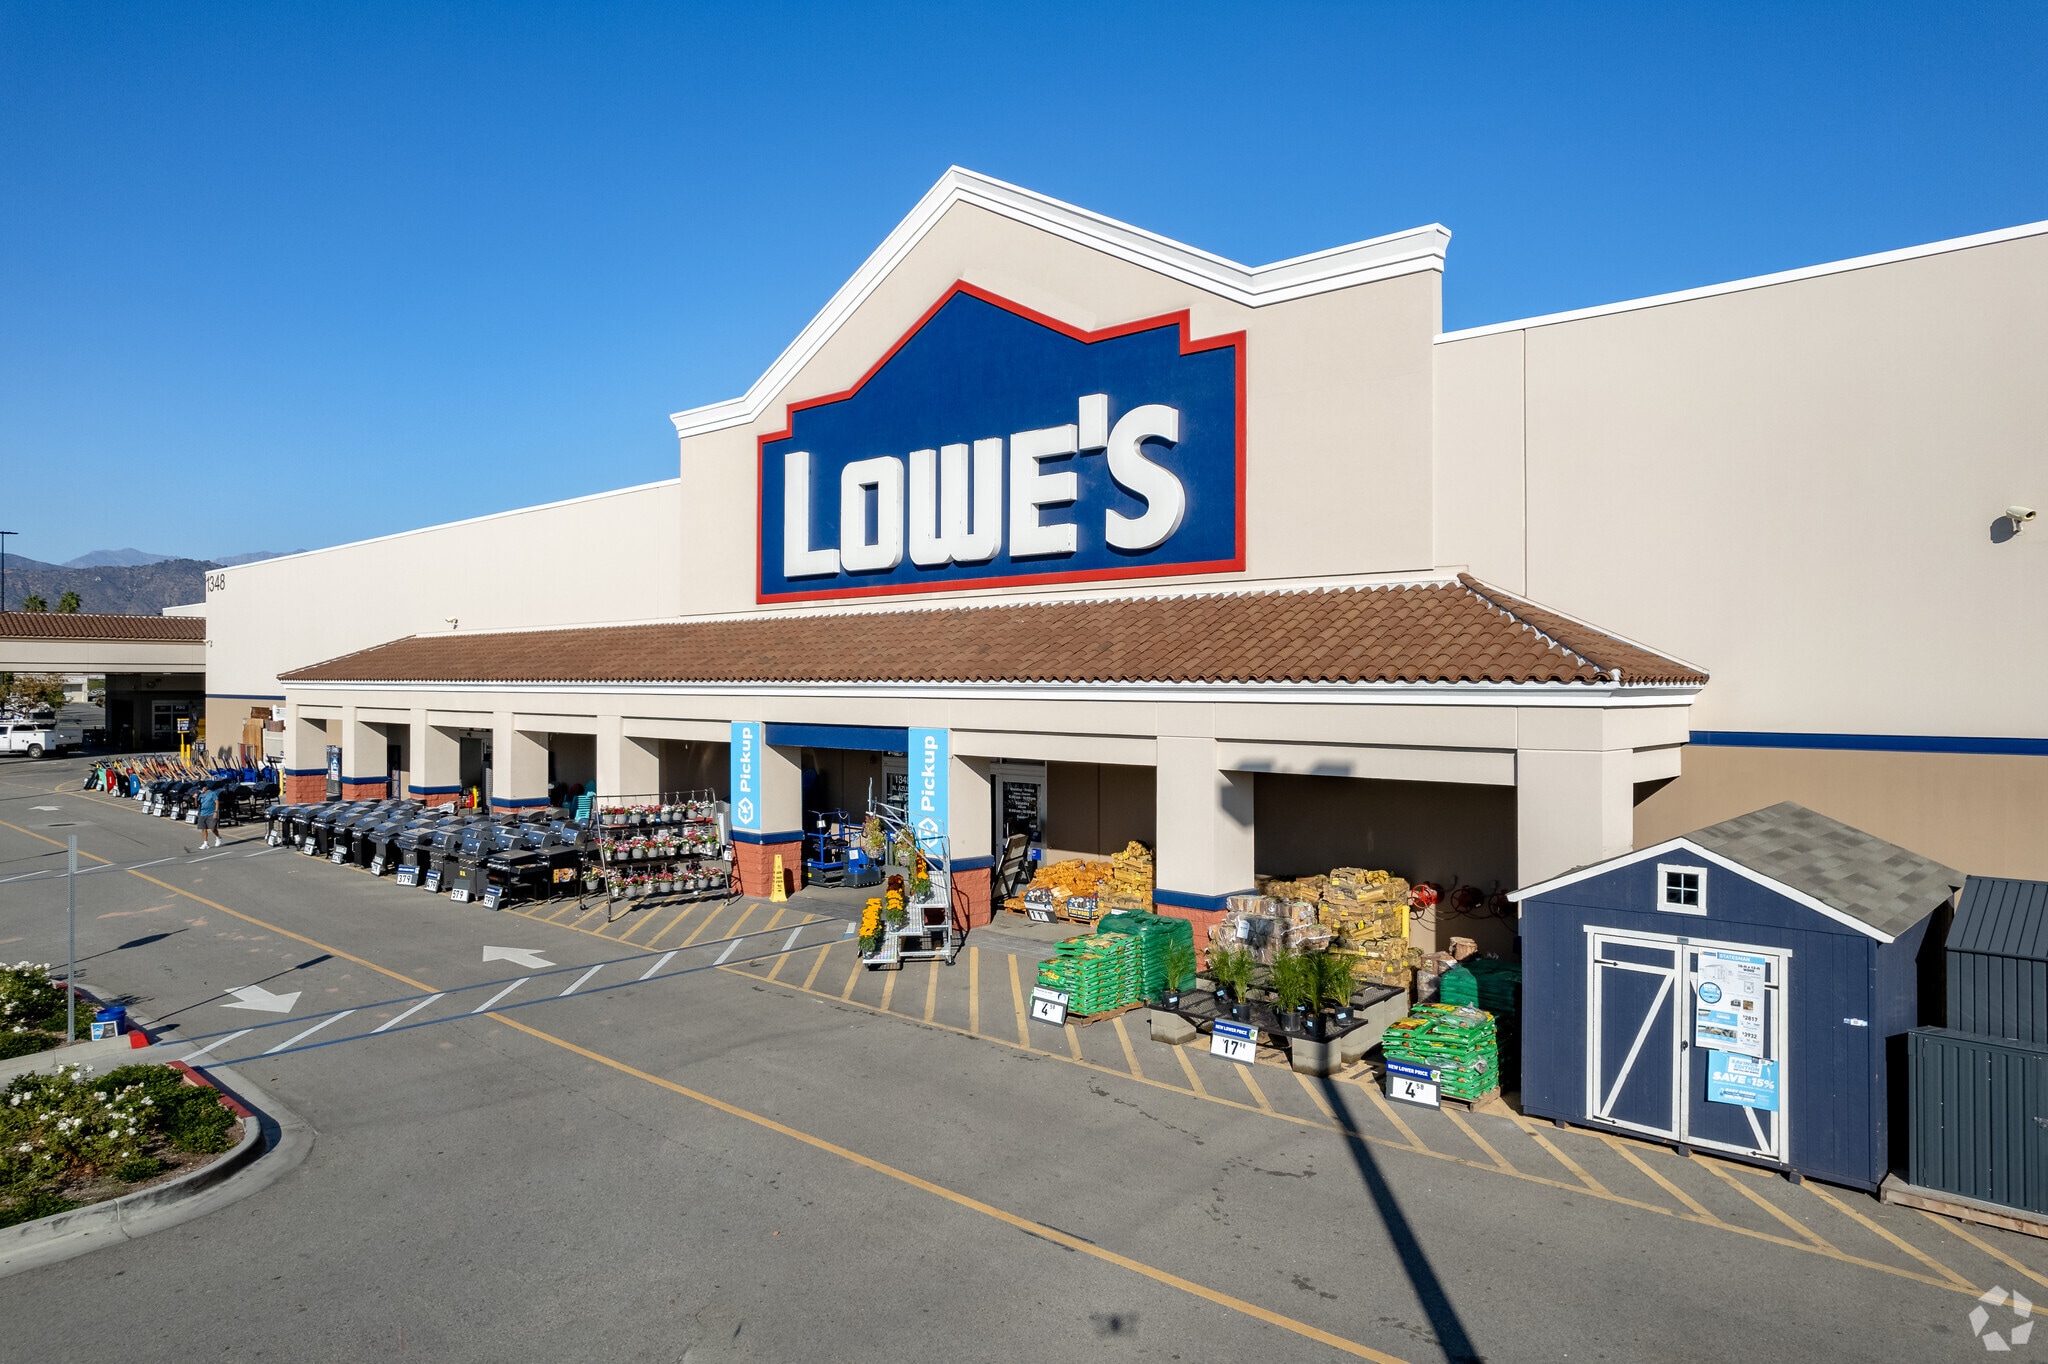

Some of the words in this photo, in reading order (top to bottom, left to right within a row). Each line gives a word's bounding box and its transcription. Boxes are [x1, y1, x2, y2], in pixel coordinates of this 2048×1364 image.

[784, 392, 1186, 578] LOWE'S
[206, 574, 226, 592] 1348
[740, 727, 753, 793] Pickup
[921, 735, 938, 812] Pickup
[398, 874, 411, 883] 379
[452, 889, 463, 899] 579
[1719, 953, 1750, 962] STATESMAN
[1237, 1028, 1247, 1036] PRICE
[1398, 1066, 1414, 1074] LOWER
[1414, 1069, 1428, 1077] PRICE
[1734, 1064, 1760, 1072] EDITION
[1713, 1071, 1746, 1085] SAVE
[1751, 1077, 1775, 1090] 15%
